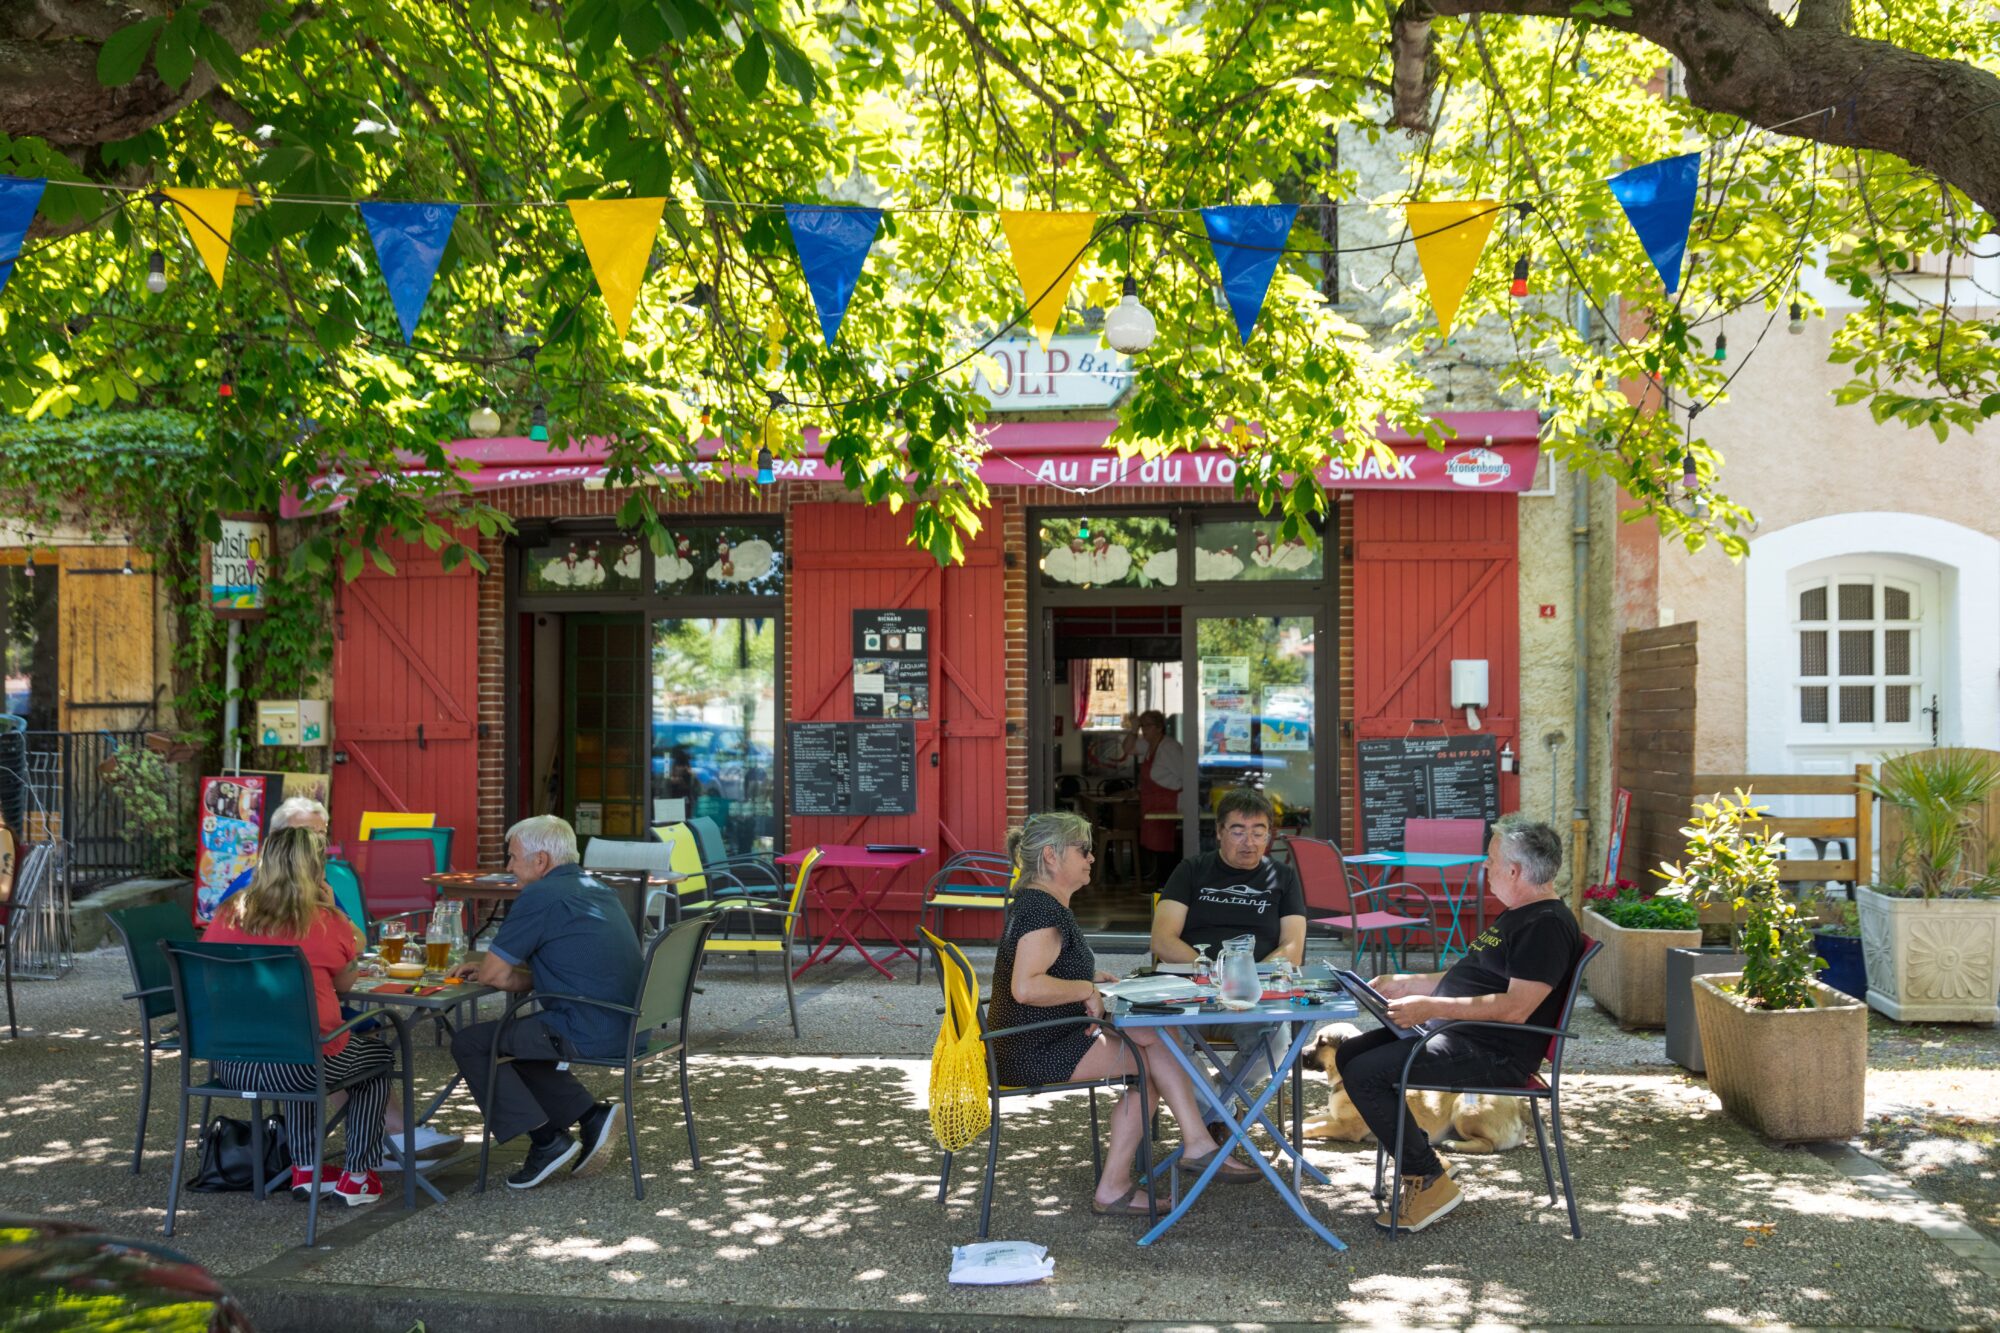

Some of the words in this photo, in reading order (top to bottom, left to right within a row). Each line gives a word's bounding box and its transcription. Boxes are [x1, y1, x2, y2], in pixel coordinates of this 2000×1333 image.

[973, 348, 1071, 396] OLP
[1078, 353, 1126, 390] BAR
[1036, 459, 1078, 482] Au
[1090, 457, 1129, 482] Fil
[1140, 456, 1182, 482] du
[1329, 455, 1416, 480] SNACK
[1448, 459, 1510, 476] Kronenbourg
[224, 563, 266, 598] pays
[1199, 894, 1272, 914] mustang
